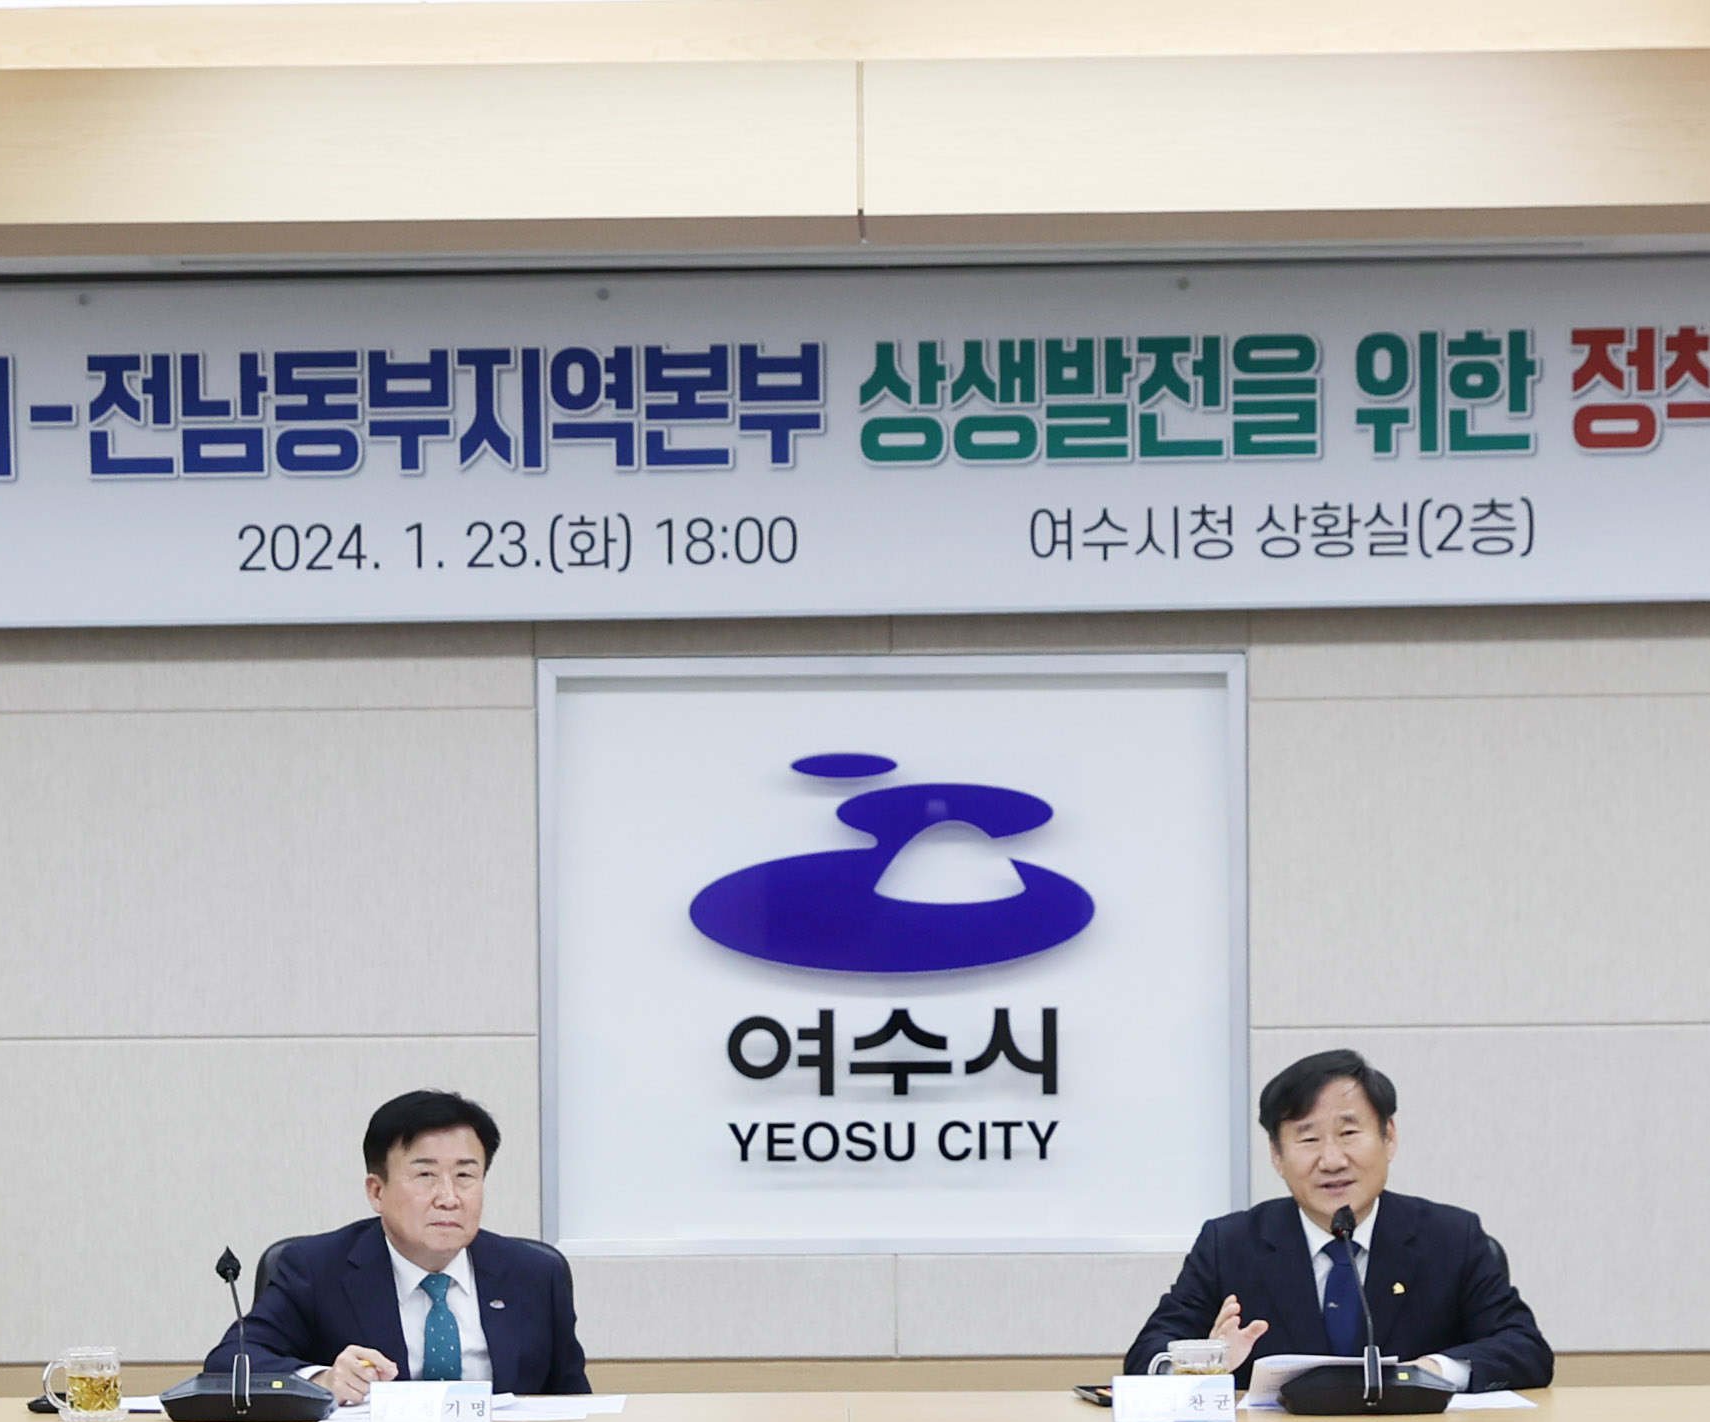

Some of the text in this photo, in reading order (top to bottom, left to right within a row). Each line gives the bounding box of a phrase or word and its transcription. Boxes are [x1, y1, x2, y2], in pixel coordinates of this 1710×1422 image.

[857, 332, 1320, 464] 상생발전을
[1354, 328, 1538, 456] 위한
[237, 511, 799, 574] 2024. 1. 23.(화) 18:00
[1028, 496, 1537, 562] 여수시청 상황실(2층)
[727, 1006, 1059, 1097] 여수시
[728, 1119, 1060, 1163] YEOSU CITY
